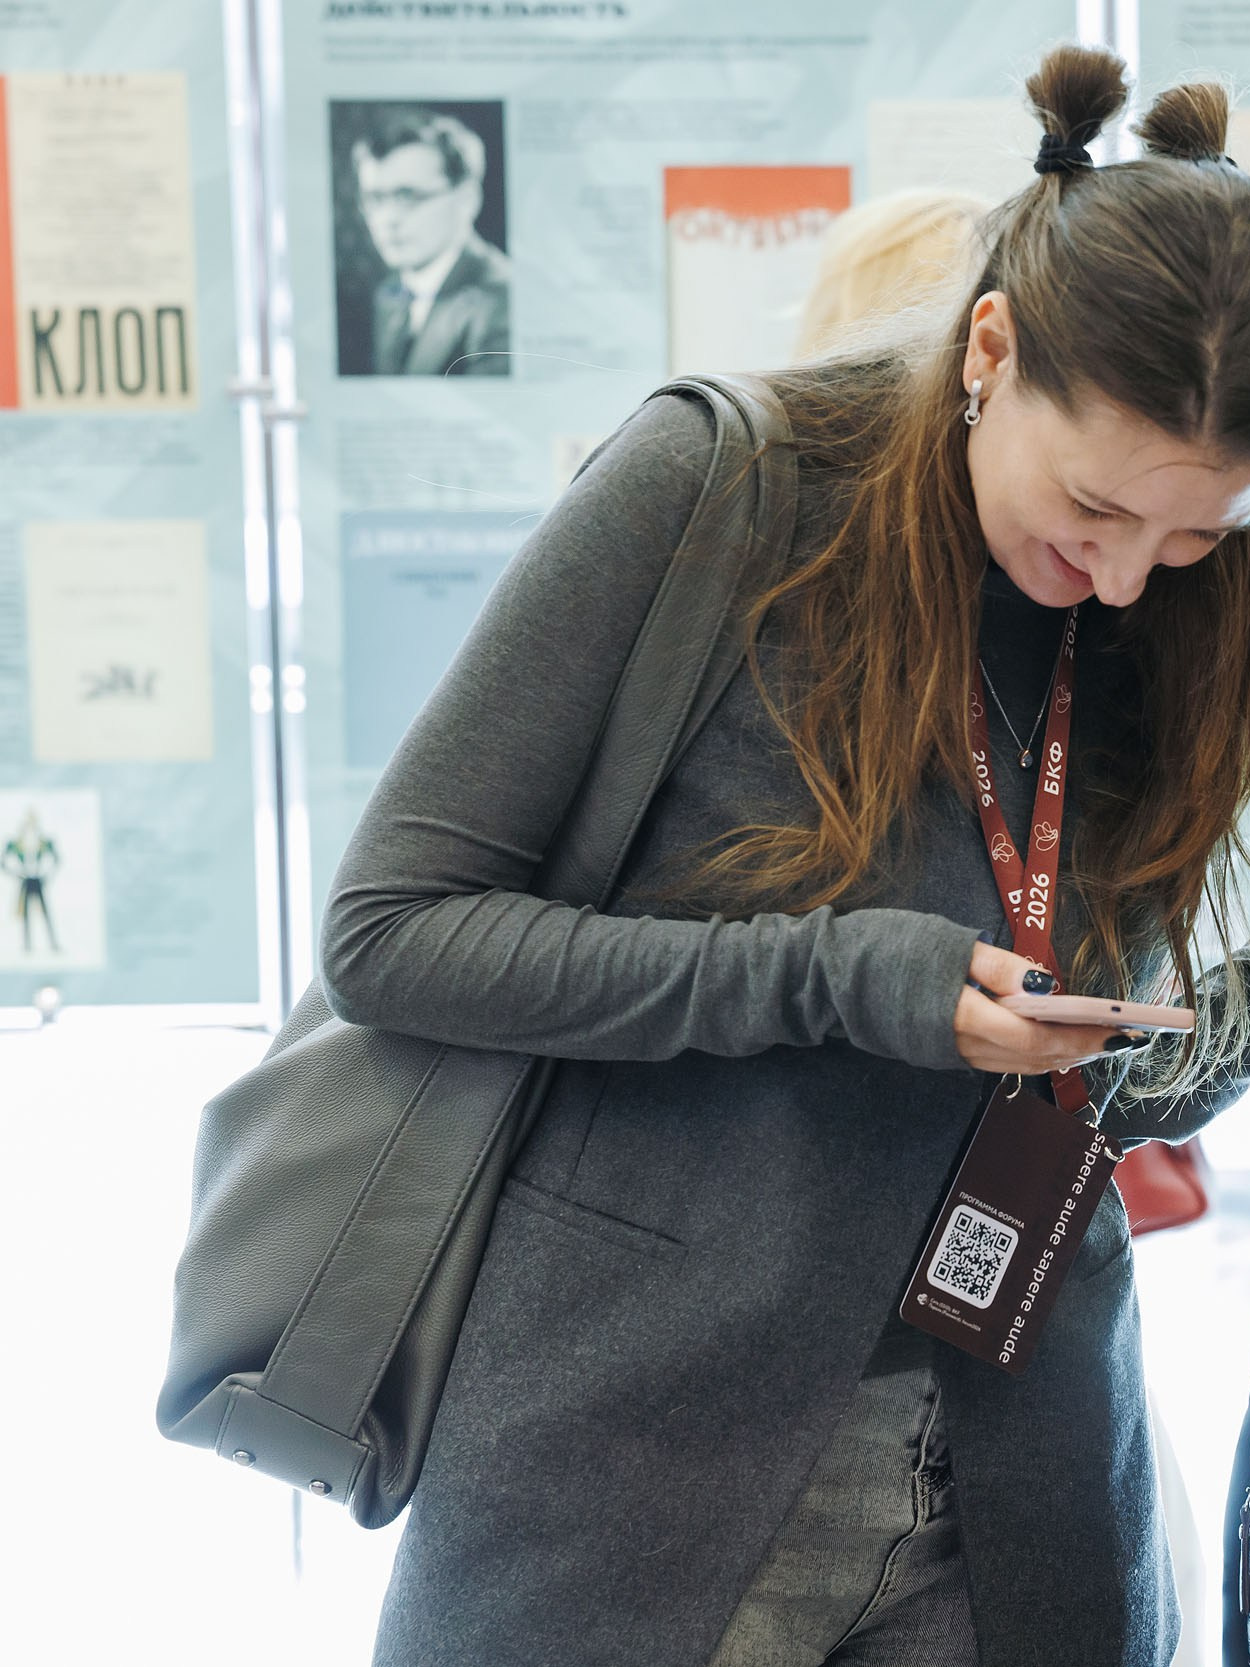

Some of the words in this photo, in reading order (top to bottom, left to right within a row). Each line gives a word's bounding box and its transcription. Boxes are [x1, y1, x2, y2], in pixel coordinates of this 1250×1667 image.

[30, 306, 190, 398] КЛОП
[972, 750, 994, 807] 2026
[1043, 741, 1063, 795] БКФ
[1025, 873, 1050, 930] 2026
[1072, 1132, 1106, 1195] sapere
[959, 1191, 998, 1215] ПРОГРАММА
[998, 1211, 1025, 1229] ФОРУМА
[1049, 1198, 1076, 1245] aude
[1021, 1249, 1054, 1312] sapere
[999, 1315, 1026, 1364] aude
